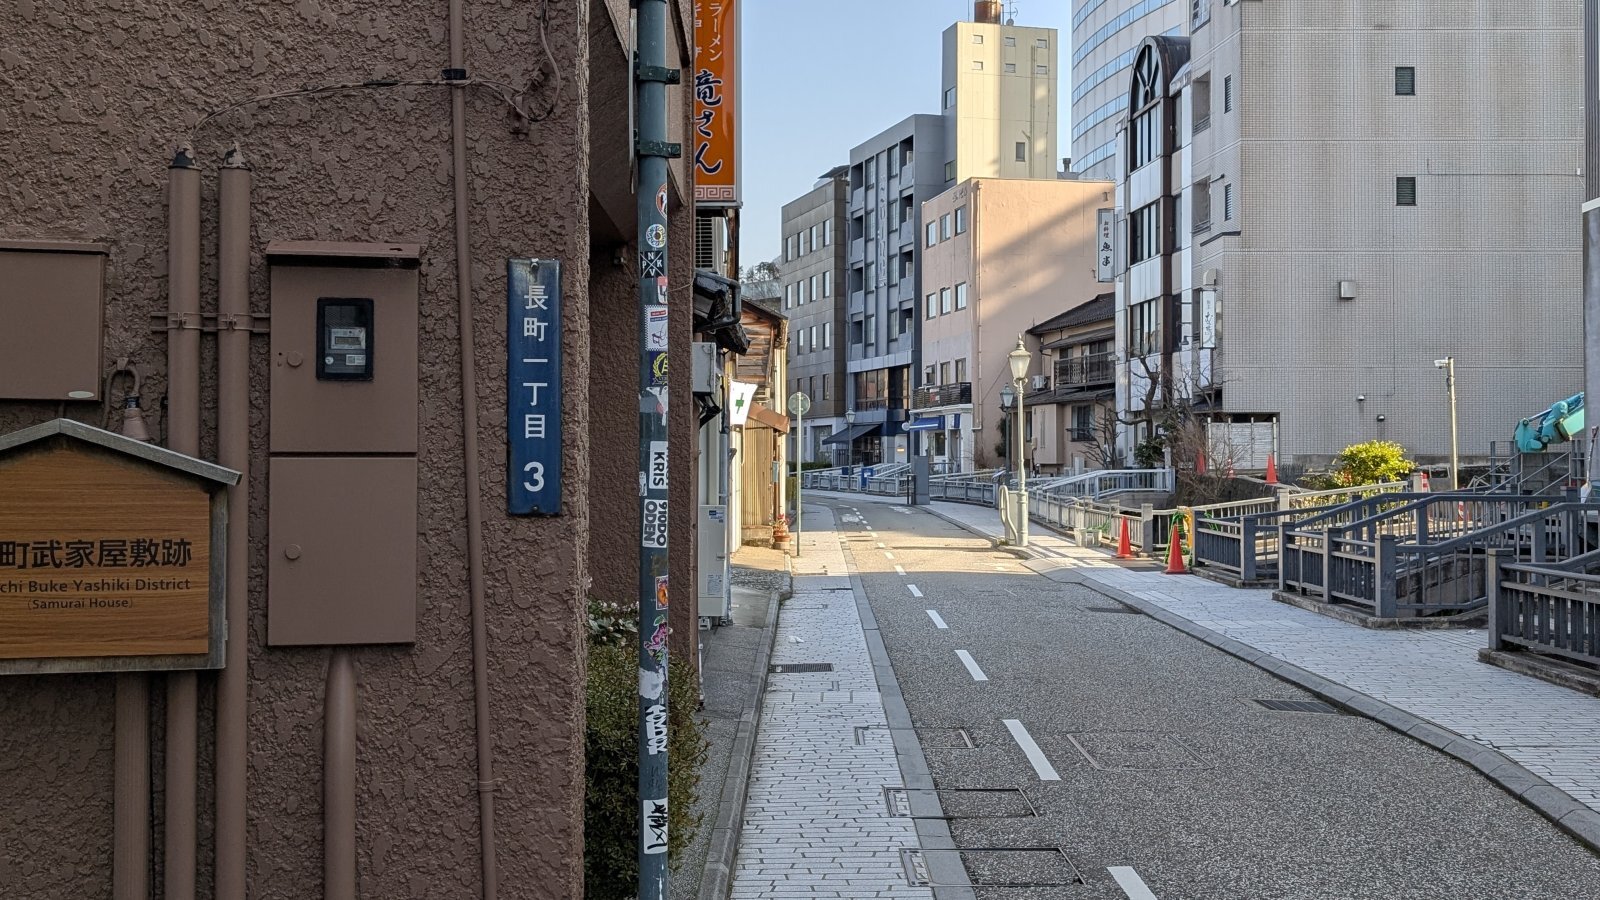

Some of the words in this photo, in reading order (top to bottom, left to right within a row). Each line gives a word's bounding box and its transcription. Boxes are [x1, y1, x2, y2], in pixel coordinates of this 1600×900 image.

[709, 2, 723, 62] ラーメン
[648, 252, 654, 260] N
[522, 285, 549, 439] 長町一丁目
[523, 461, 545, 492] 3
[653, 451, 664, 486] KRIS
[0, 538, 192, 569] 町武家屋敷跡
[28, 579, 68, 593] Buke
[73, 578, 130, 592] Yashiki
[135, 577, 191, 591] District
